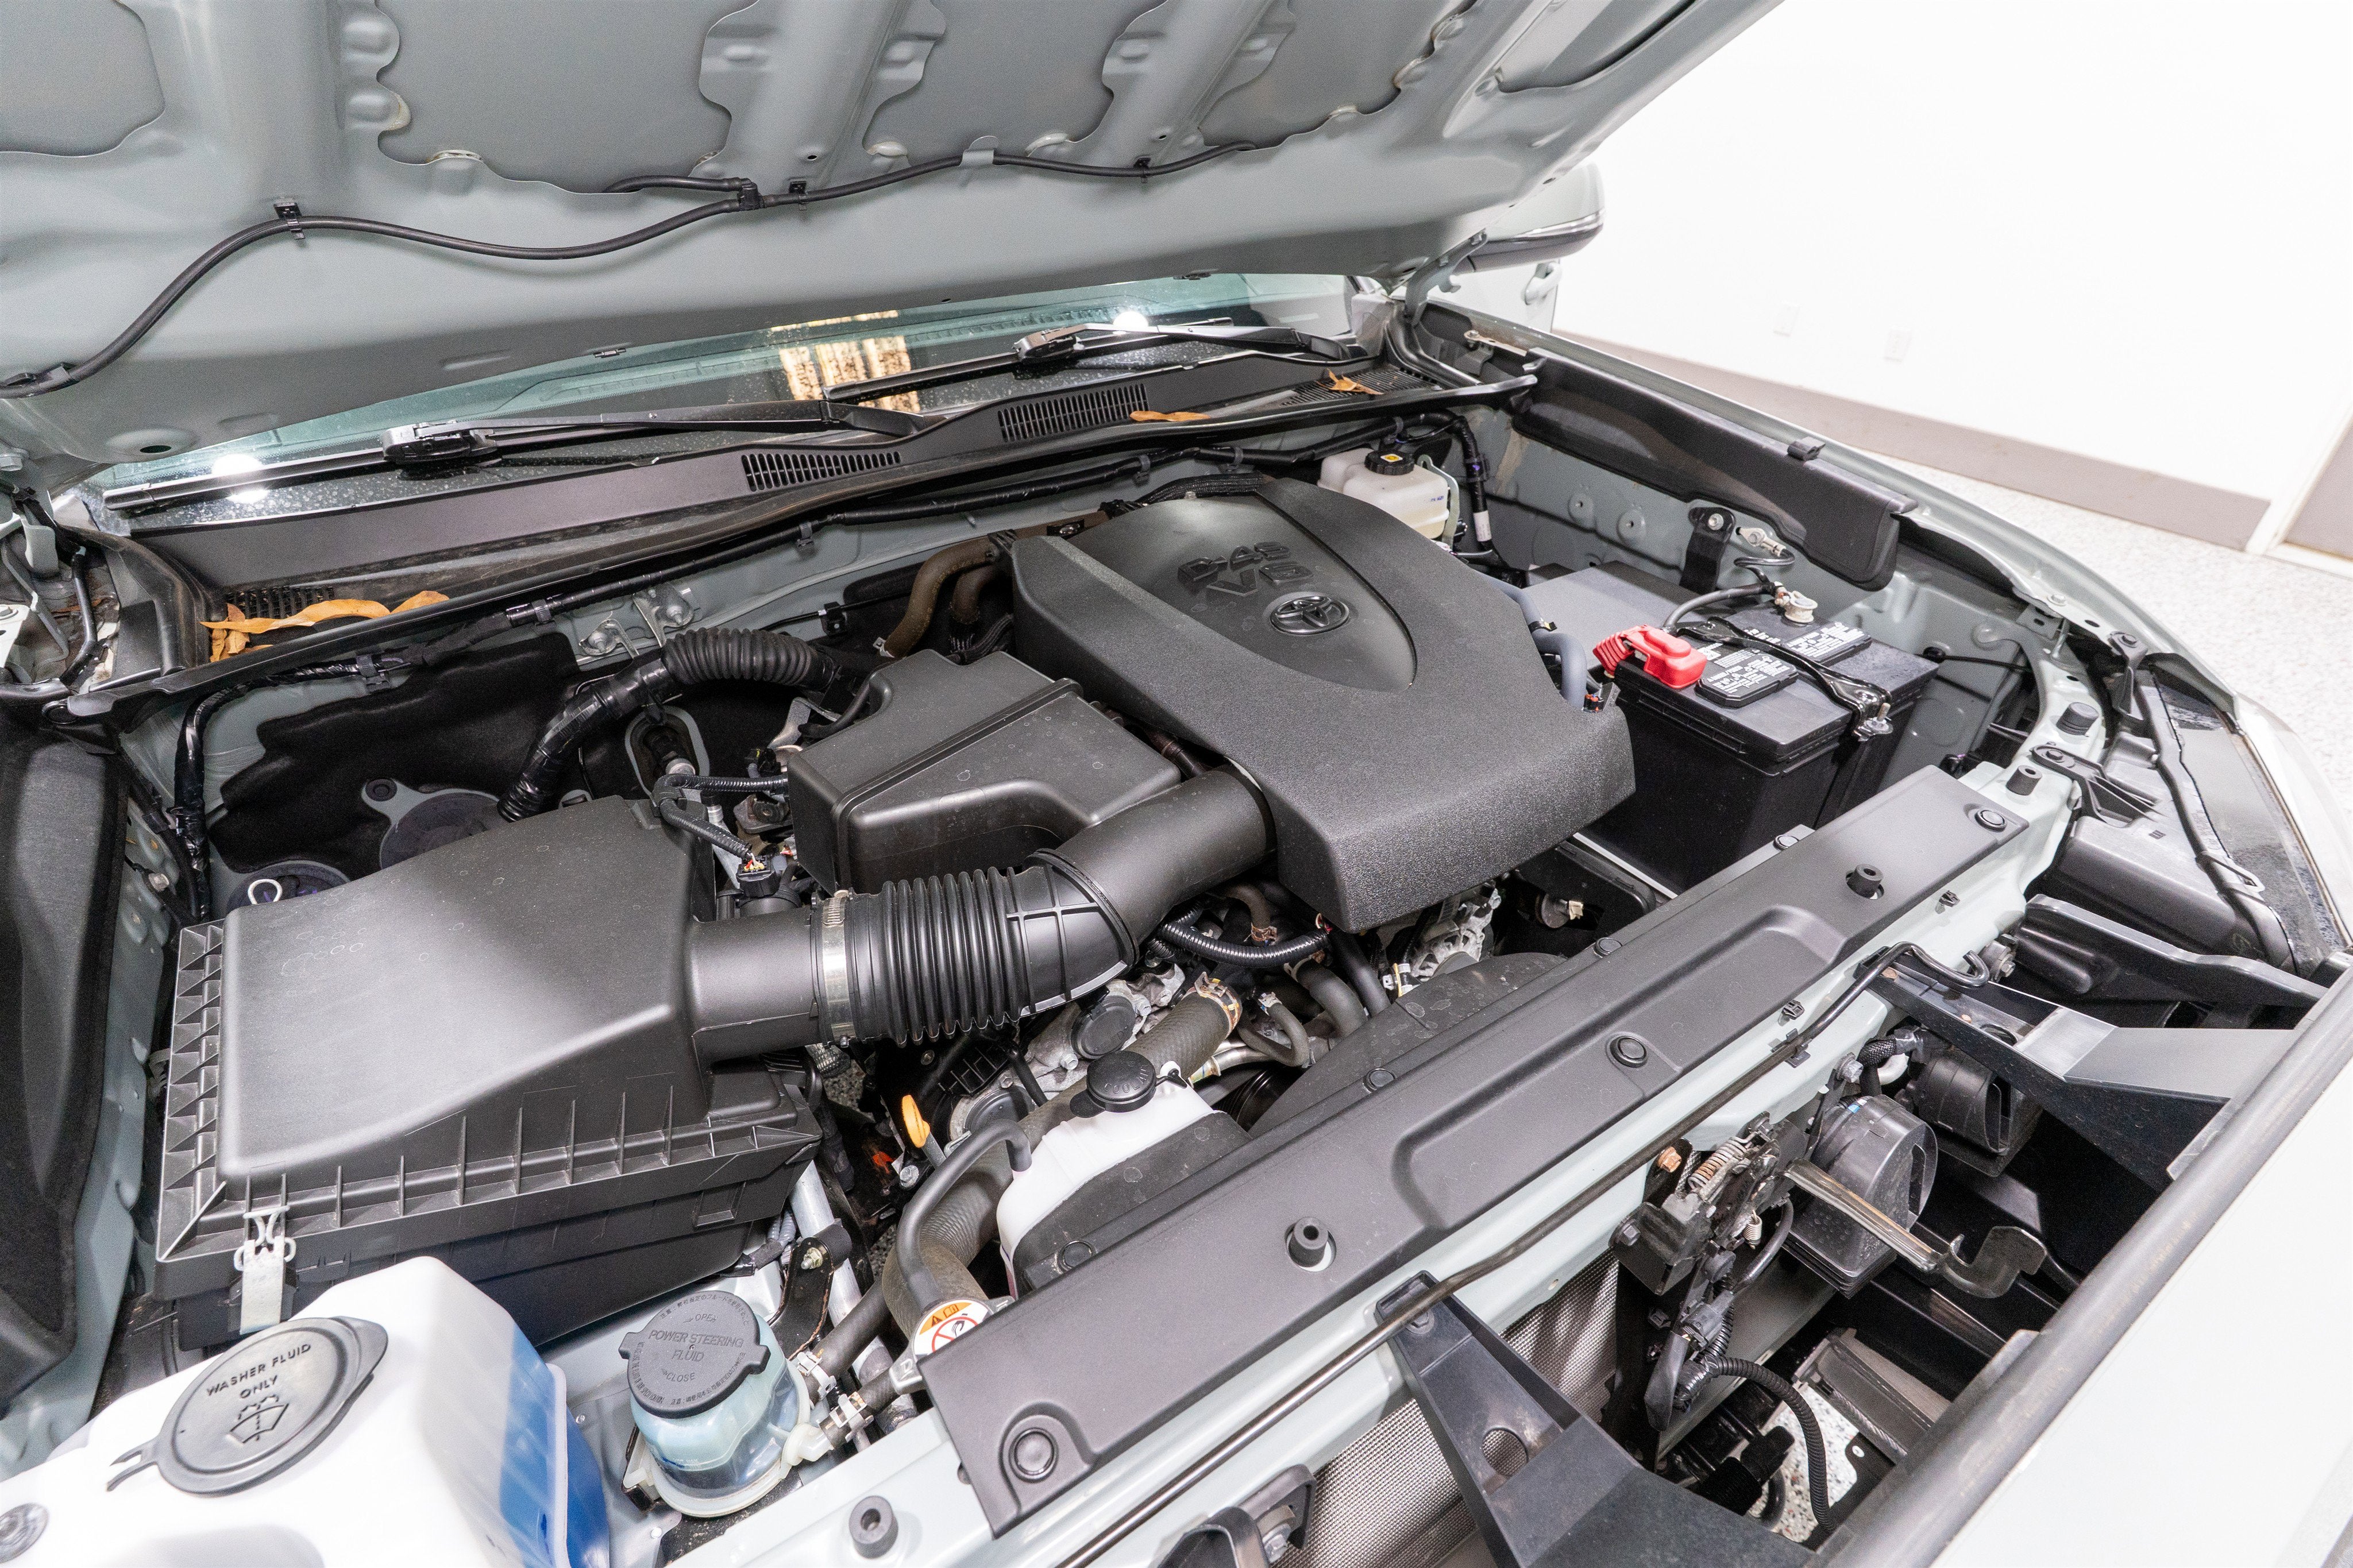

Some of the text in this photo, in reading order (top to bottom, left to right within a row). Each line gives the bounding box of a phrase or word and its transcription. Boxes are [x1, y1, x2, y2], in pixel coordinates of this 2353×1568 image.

[695, 1314, 718, 1323] OPEN
[649, 1330, 744, 1348] POWER STEERING
[672, 1349, 704, 1362] FLUID
[206, 1343, 311, 1396] WASHER FLUID
[666, 1372, 695, 1382] CLOSE
[240, 1374, 277, 1399] ONLY
